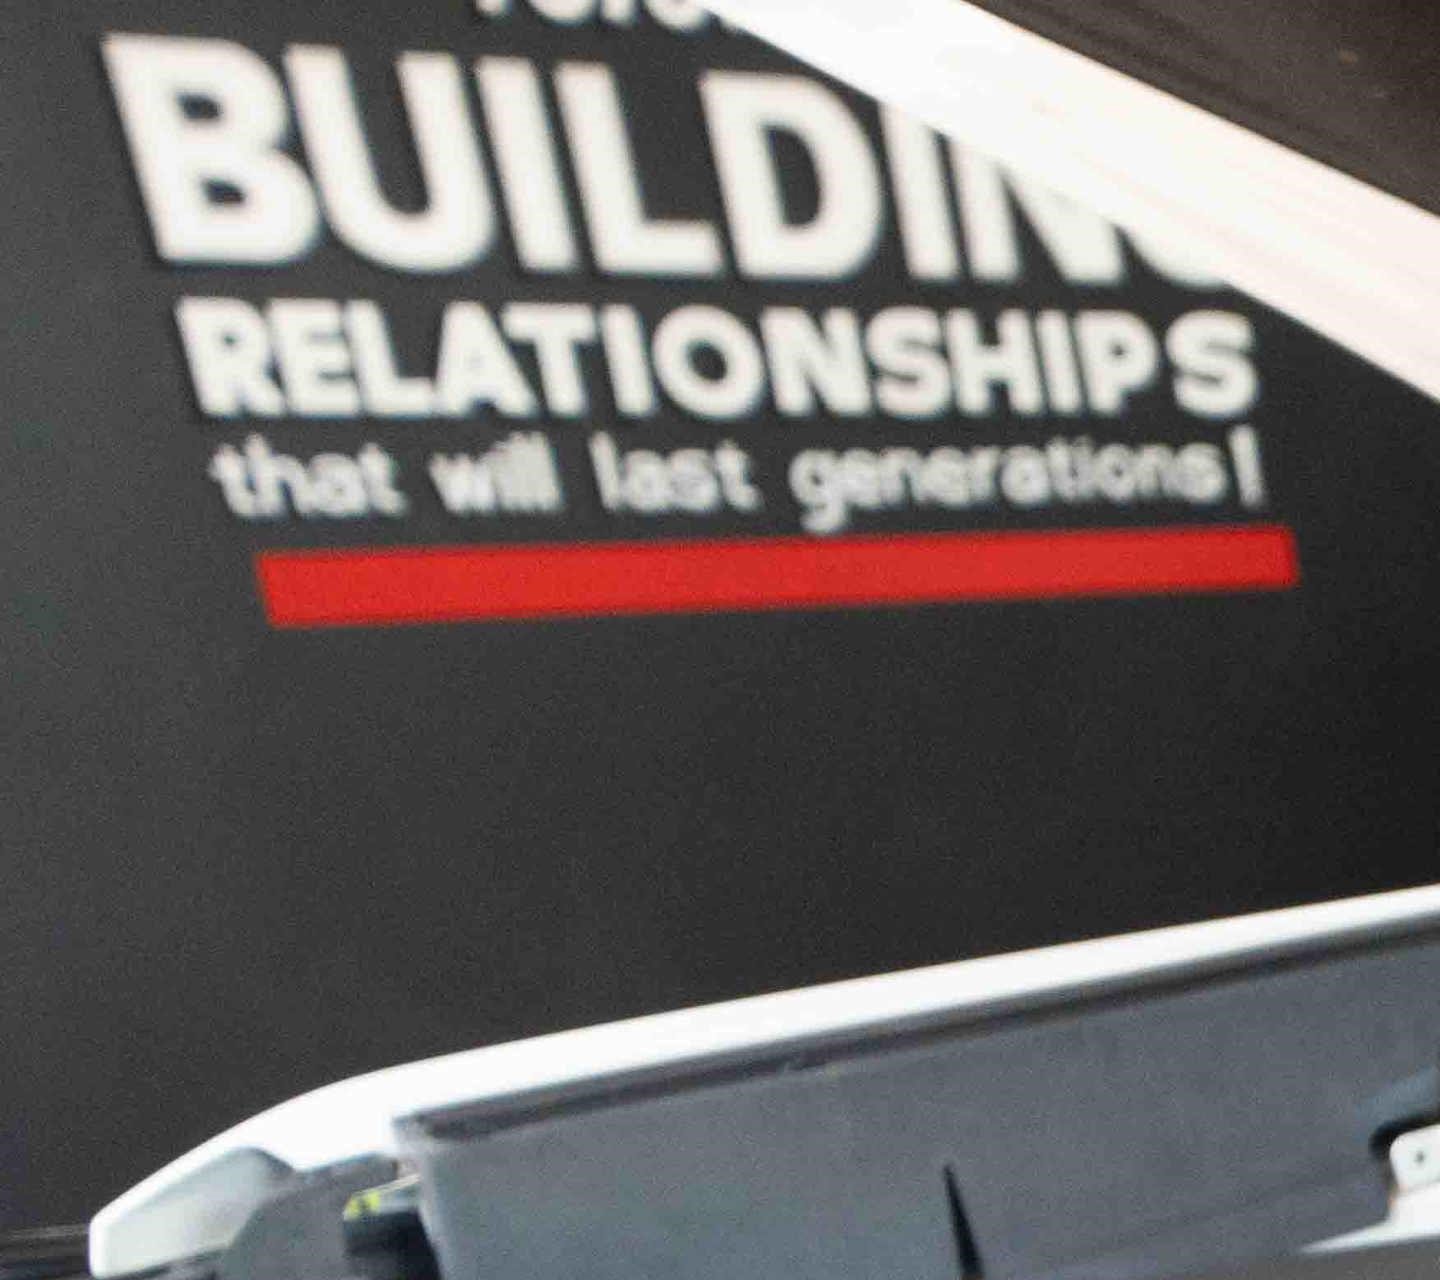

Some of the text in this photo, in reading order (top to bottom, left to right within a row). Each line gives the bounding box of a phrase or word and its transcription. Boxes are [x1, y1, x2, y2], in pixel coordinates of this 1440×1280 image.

[174, 296, 1260, 420] RELATIONSHIPS
[208, 432, 406, 518] that
[427, 430, 564, 514] will
[588, 431, 761, 512] last
